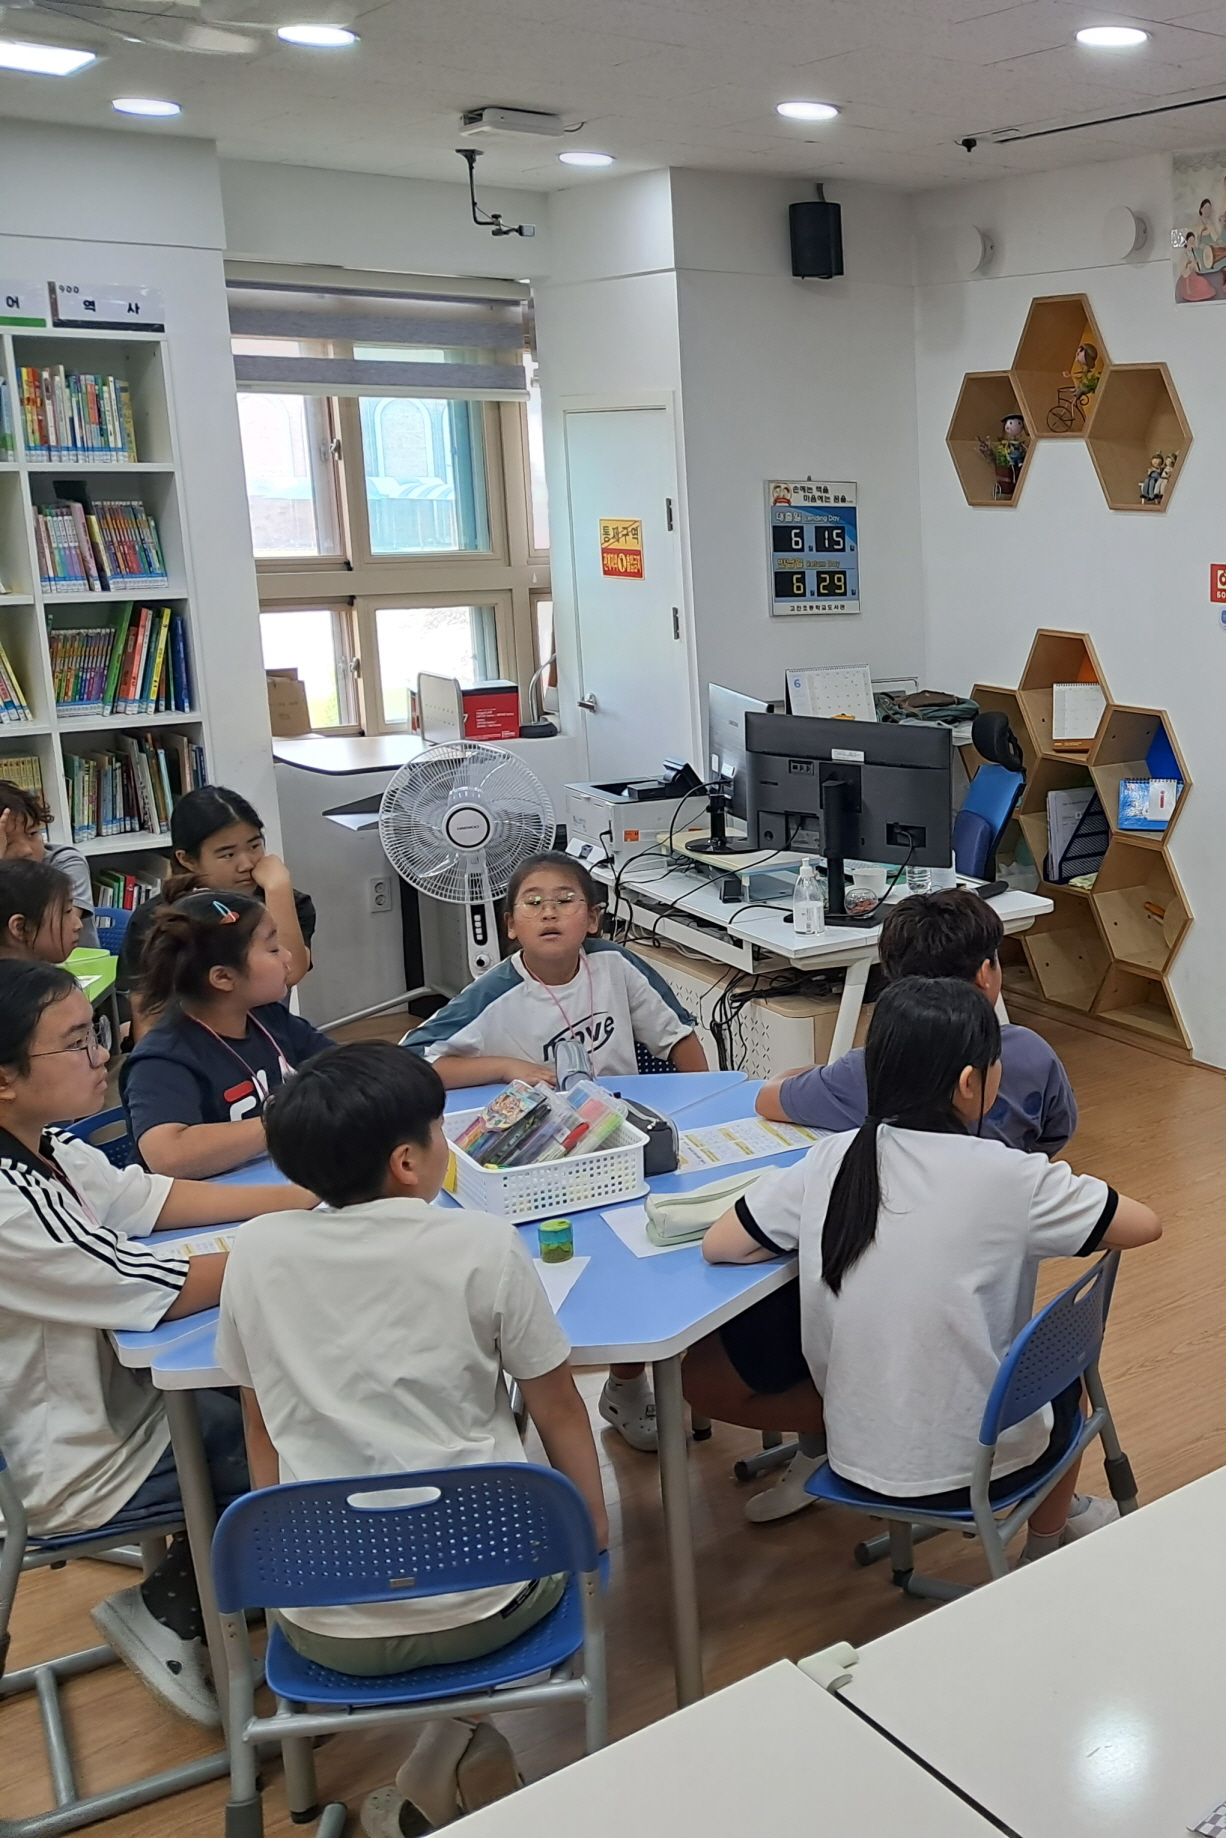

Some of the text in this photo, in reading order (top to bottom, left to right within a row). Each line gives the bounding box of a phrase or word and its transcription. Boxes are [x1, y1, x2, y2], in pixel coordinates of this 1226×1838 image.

[58, 285, 80, 294] 900
[6, 296, 20, 309] 어
[791, 529, 802, 549] 6
[824, 529, 843, 549] 15
[792, 574, 804, 594] 6
[820, 574, 845, 593] 29
[794, 679, 801, 689] 6
